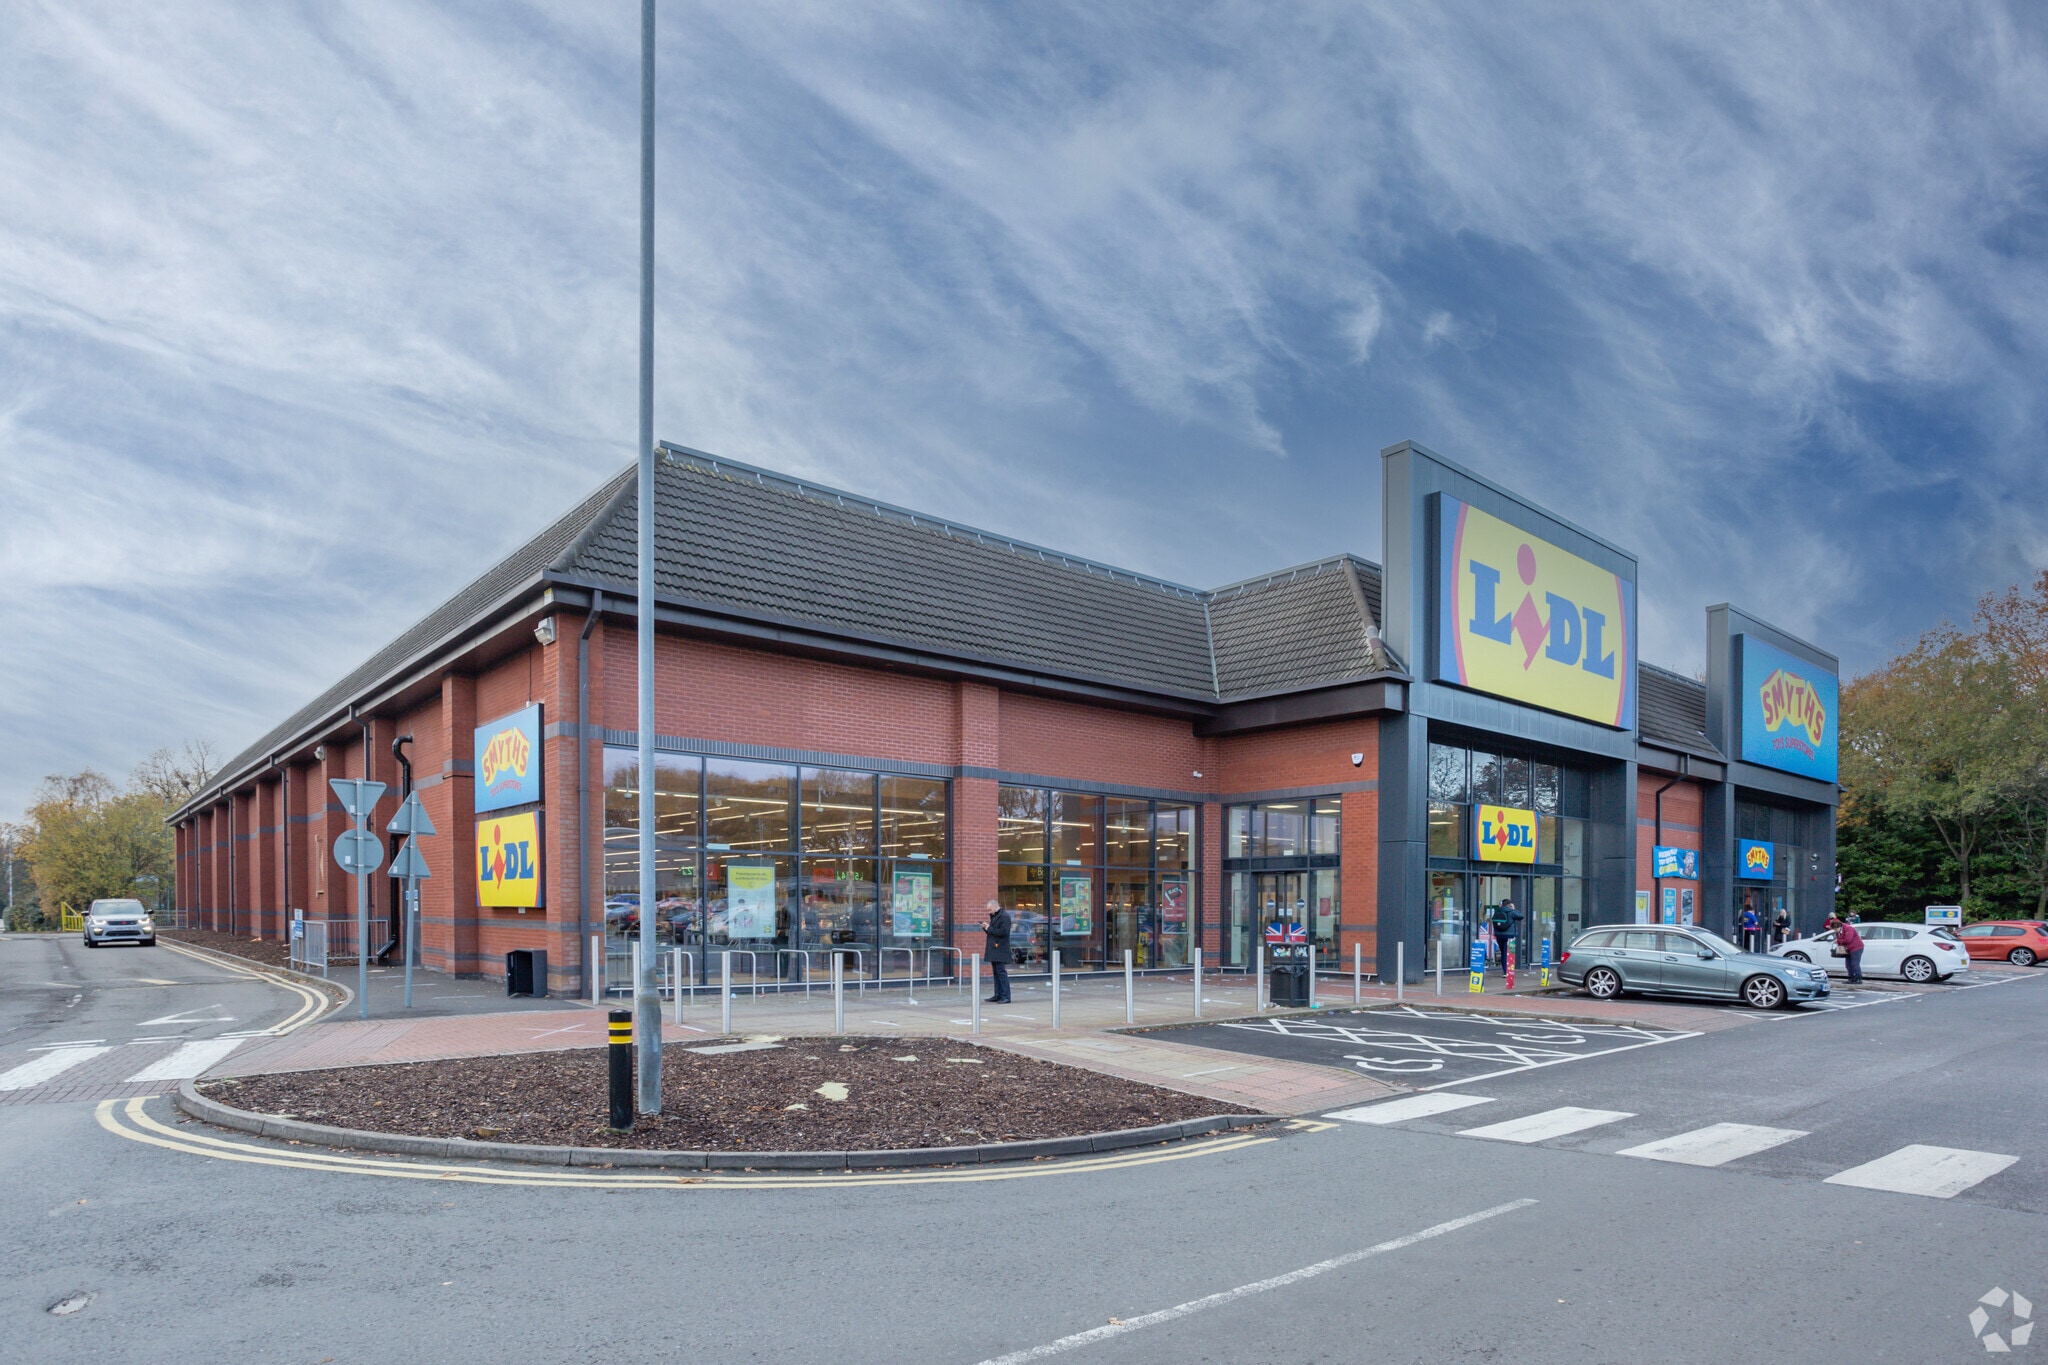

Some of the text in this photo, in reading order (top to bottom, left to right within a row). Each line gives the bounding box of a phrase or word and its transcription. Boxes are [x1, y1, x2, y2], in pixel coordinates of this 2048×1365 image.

[1469, 543, 1615, 680] LIDL
[1762, 678, 1824, 742] SMYTHS
[483, 734, 529, 783] SMYTHS
[480, 824, 534, 891] LIDL
[1482, 810, 1533, 852] LIDL
[1747, 849, 1769, 867] SMYTHS
